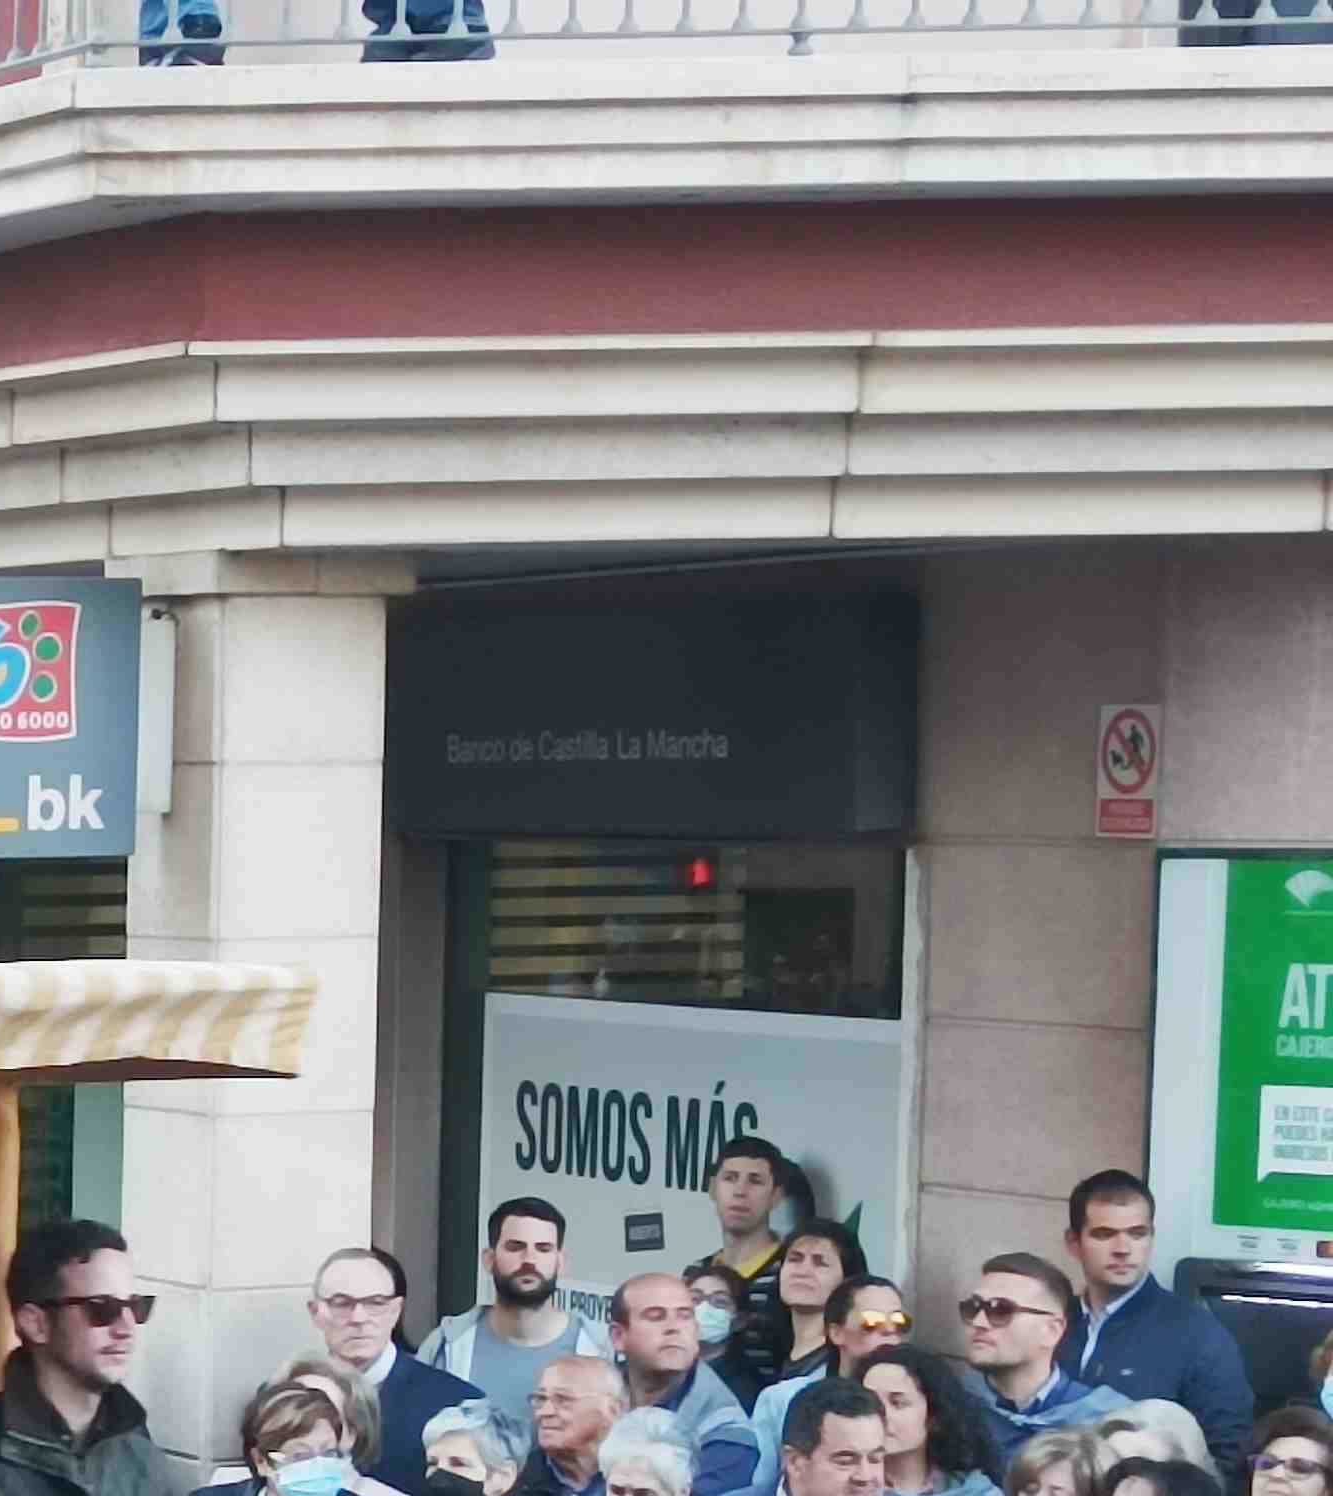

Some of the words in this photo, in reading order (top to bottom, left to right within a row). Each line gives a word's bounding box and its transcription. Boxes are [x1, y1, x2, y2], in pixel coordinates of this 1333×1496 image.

[17, 710, 70, 730] 6000
[446, 732, 505, 764] Banco
[509, 735, 534, 761] de
[539, 730, 609, 761] Castilla
[617, 730, 642, 760] La
[646, 728, 729, 760] Mancha
[515, 1080, 652, 1185] SOMOS
